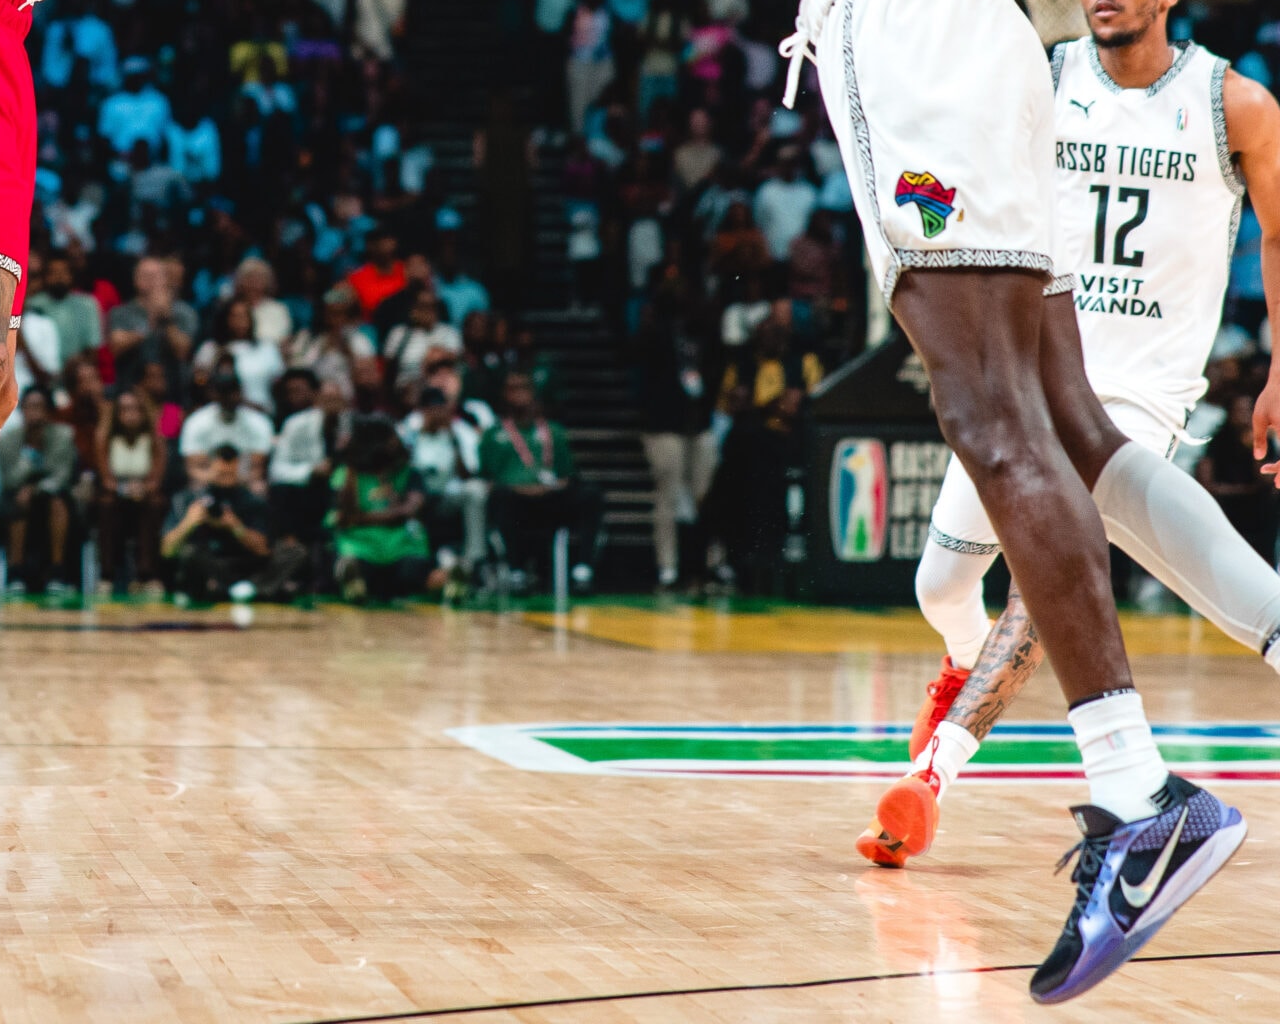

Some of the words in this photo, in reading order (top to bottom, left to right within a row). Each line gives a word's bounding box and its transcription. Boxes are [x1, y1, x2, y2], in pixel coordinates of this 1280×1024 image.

[1056, 141, 1107, 173] RSSB
[1117, 145, 1197, 182] TIGERS
[1089, 184, 1150, 267] 12
[1080, 274, 1144, 295] VISIT
